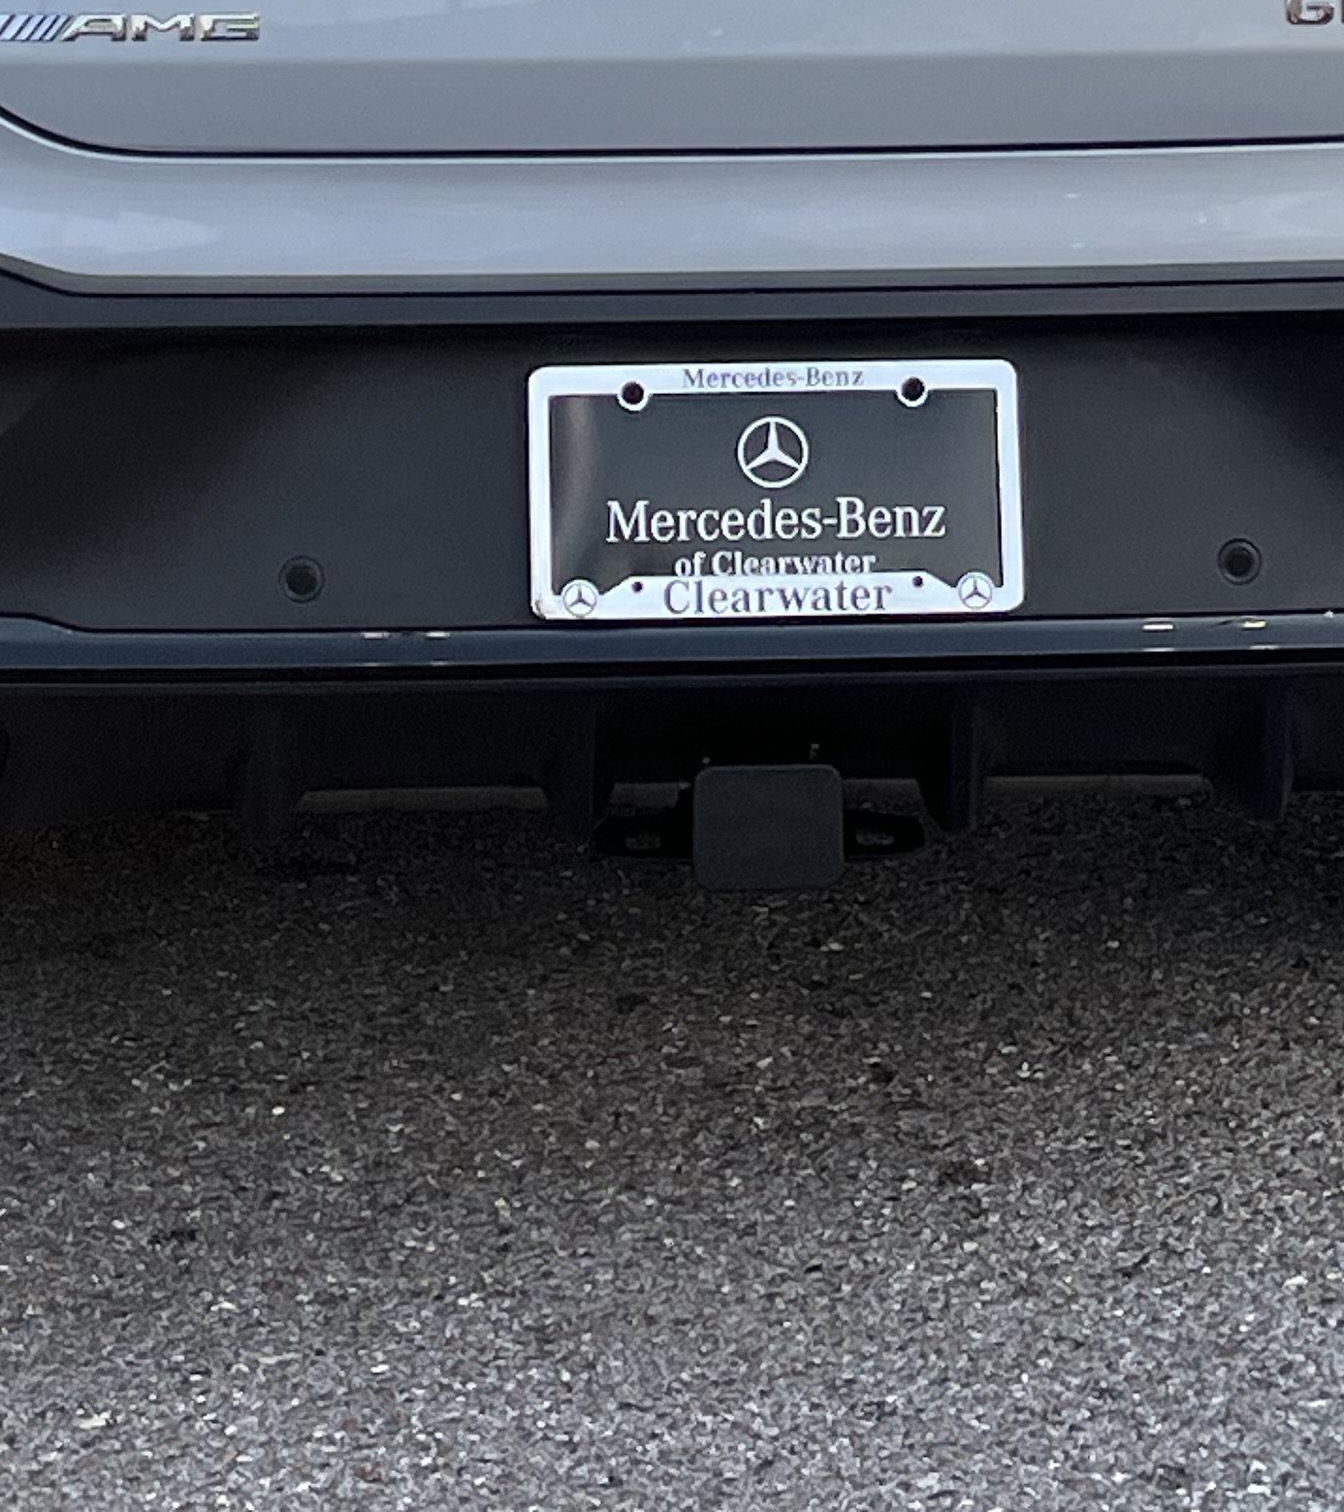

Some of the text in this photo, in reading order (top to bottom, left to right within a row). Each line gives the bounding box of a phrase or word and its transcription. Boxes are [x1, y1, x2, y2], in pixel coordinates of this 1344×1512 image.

[59, 13, 261, 42] AMG
[681, 366, 864, 389] Mercedes-Benz
[605, 496, 947, 543] Mercedes-Benz
[674, 551, 876, 578] of Clearwater
[663, 580, 893, 615] Clearwater
